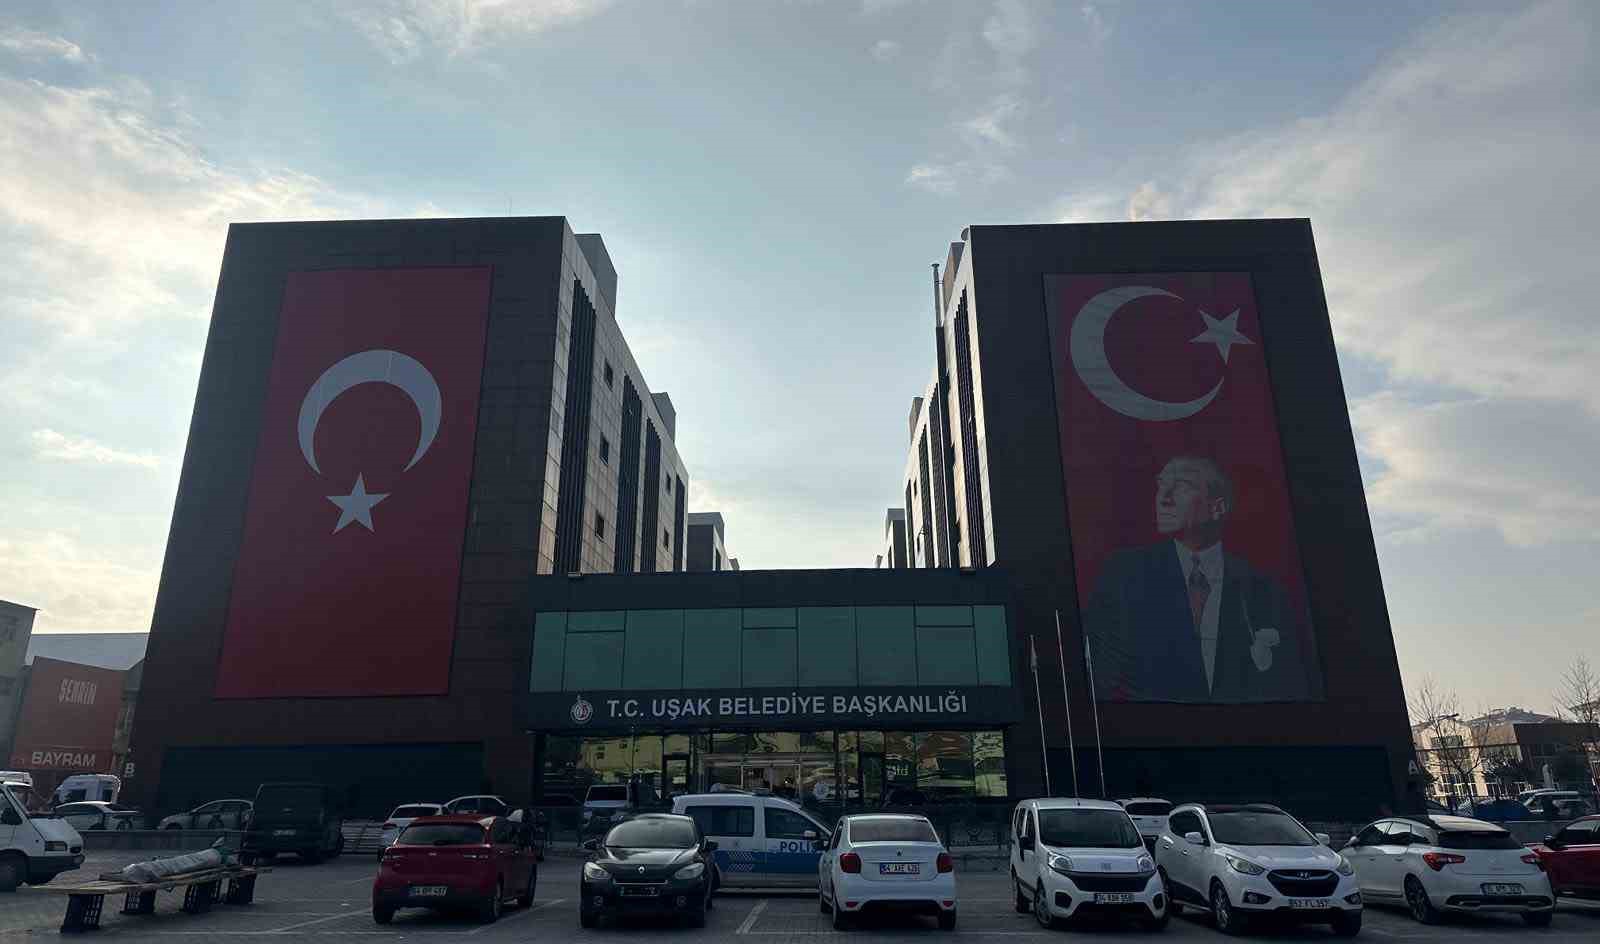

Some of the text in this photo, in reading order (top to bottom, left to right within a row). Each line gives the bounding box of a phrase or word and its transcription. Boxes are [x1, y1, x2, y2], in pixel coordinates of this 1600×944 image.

[607, 690, 967, 720] T.C. UŞAK BELEDİYE BAŞKANLIĞI
[31, 751, 96, 767] BAYRAM
